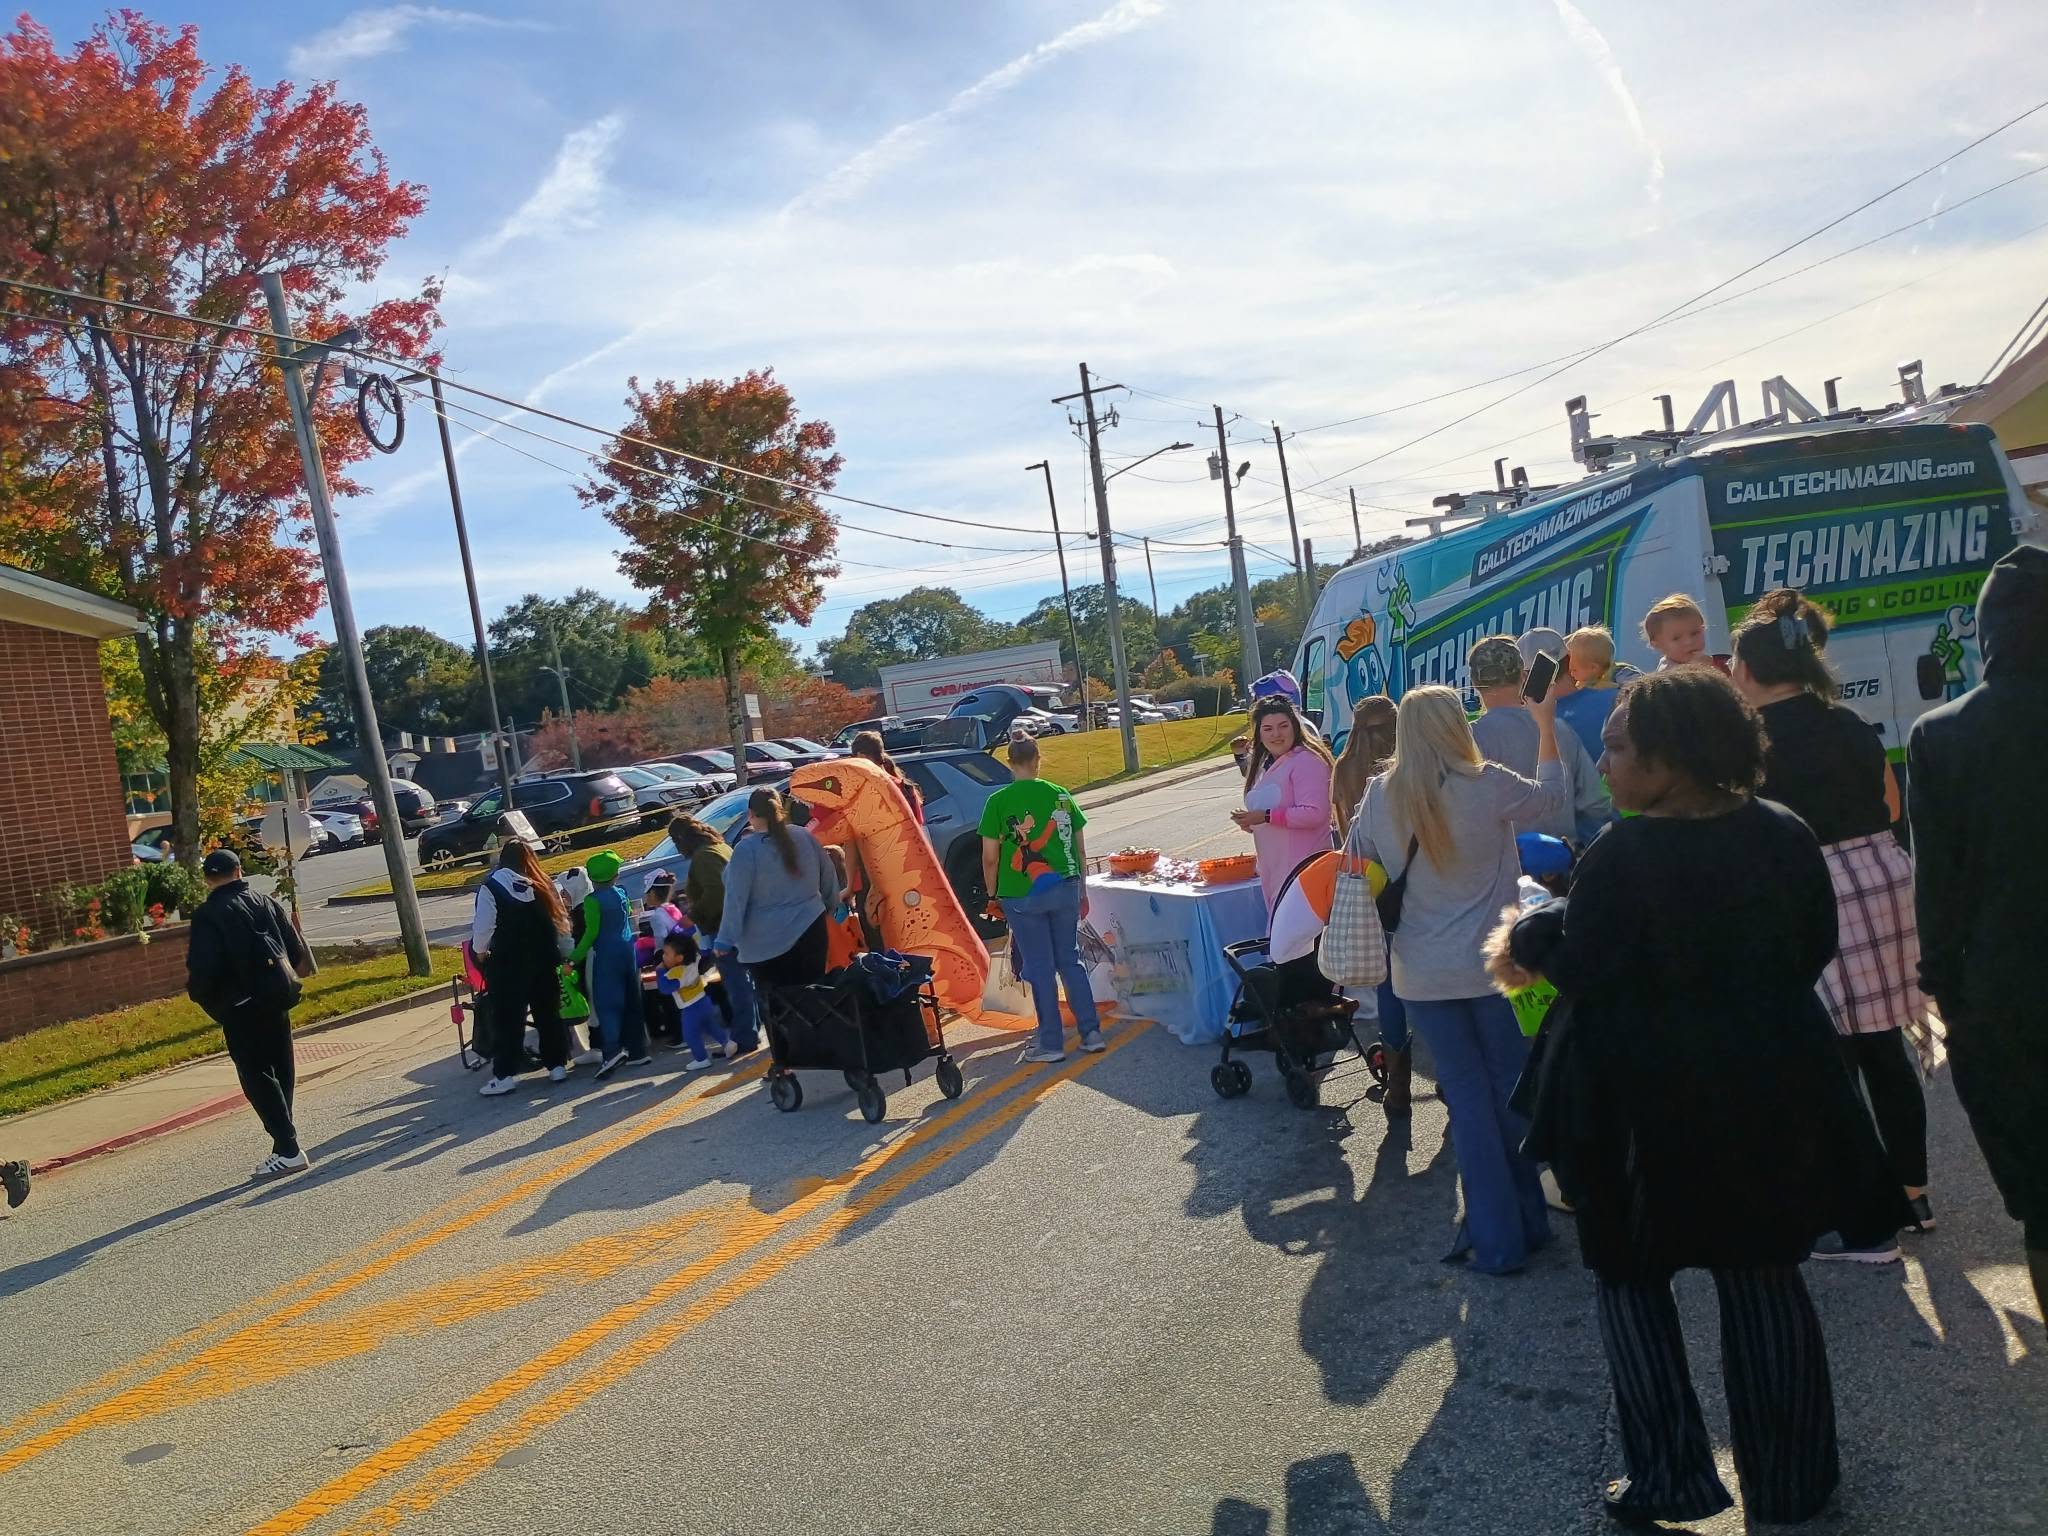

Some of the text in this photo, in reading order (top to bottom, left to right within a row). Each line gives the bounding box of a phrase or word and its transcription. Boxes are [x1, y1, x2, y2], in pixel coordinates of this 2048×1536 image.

[1726, 458, 1975, 504] CALLTECHMAZING.com
[1477, 482, 1633, 577] CALLTECHMAZING.com
[1742, 505, 1989, 595] TECHMAZING
[1883, 578, 1981, 609] COOLIN
